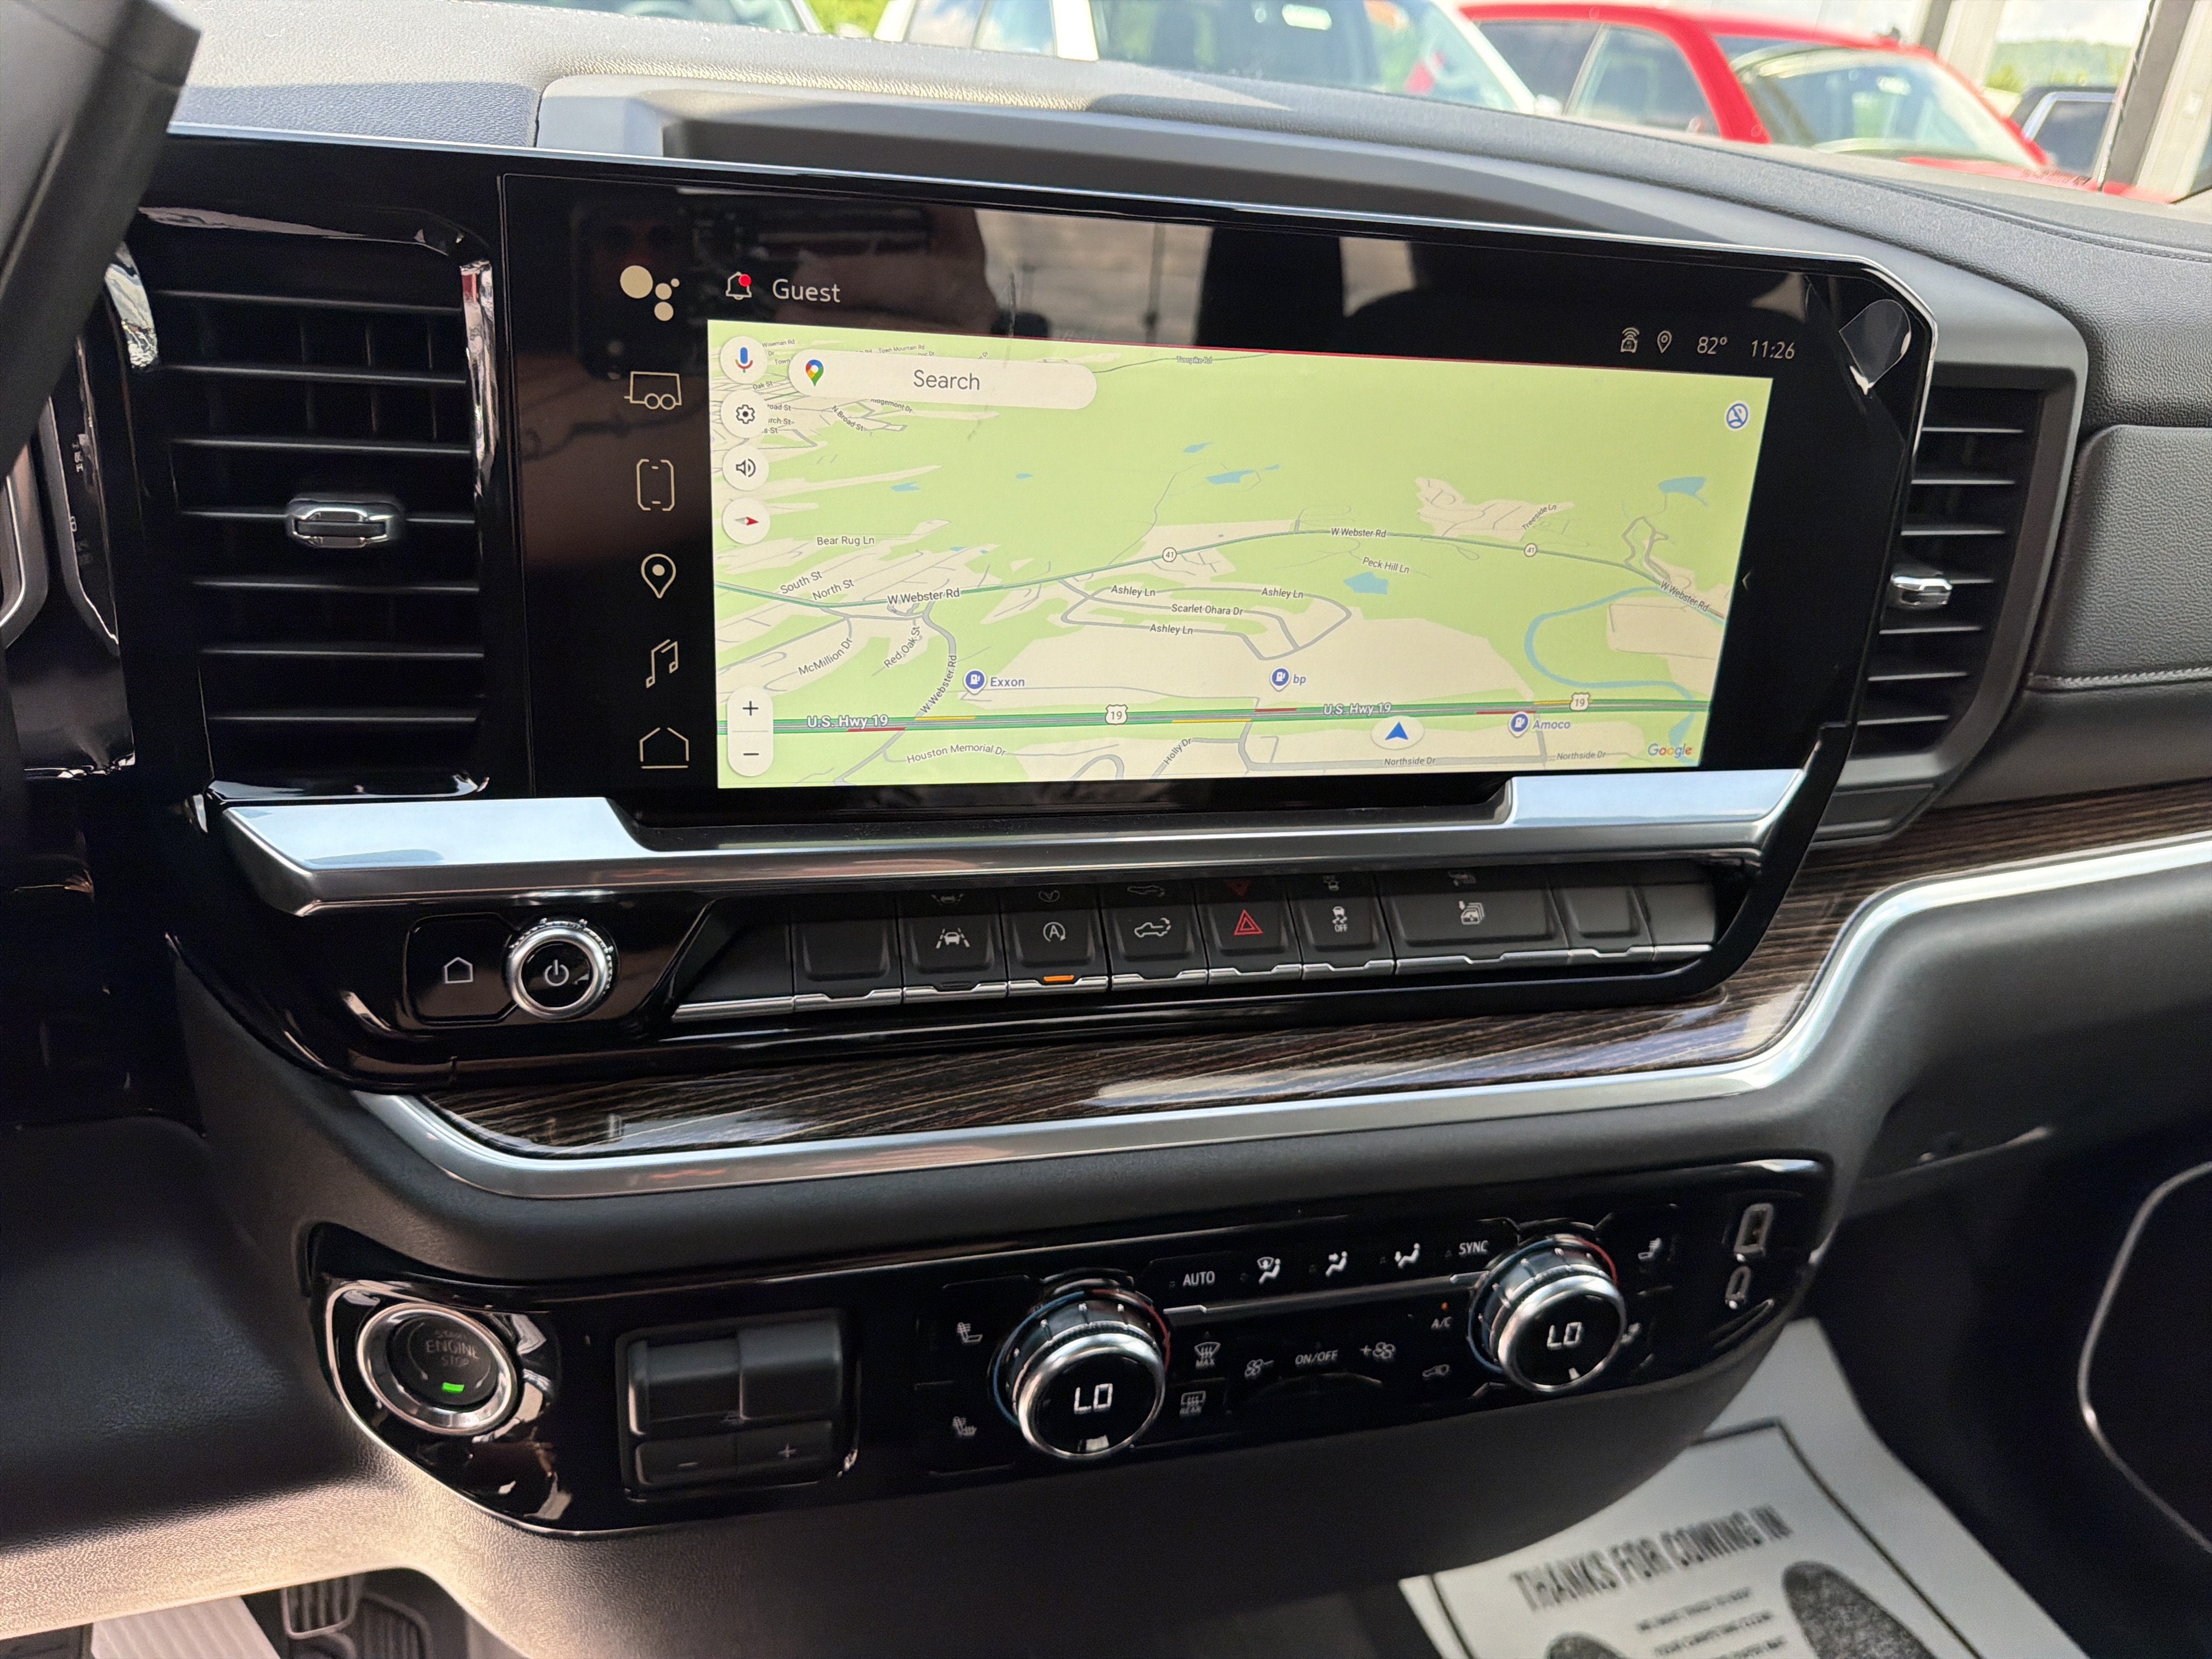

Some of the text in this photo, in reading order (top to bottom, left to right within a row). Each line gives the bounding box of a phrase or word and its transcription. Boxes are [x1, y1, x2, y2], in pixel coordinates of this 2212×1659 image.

[772, 279, 840, 303] Guest
[1696, 336, 1728, 354] 82°
[1751, 340, 1796, 359] 11:26
[913, 369, 980, 390] Search
[837, 411, 856, 427] Broad
[855, 422, 864, 432] St
[1521, 507, 1547, 531] Treeside
[1331, 527, 1387, 538] W Webster Rd
[817, 536, 874, 547] Bear Rug Ln
[1165, 550, 1175, 558] 41
[1362, 556, 1409, 574] Peck Hill Ln
[780, 569, 823, 595] South St
[812, 578, 855, 601] North St
[887, 587, 960, 605] W Webster Rd
[1110, 585, 1156, 599] Ashley Ln
[1261, 587, 1304, 600] Ashley Ln
[1660, 580, 1710, 612] W Webster Rd
[1171, 603, 1243, 616] Scarlet Ohara Dr
[1150, 624, 1193, 636] Ashley Ln
[883, 625, 920, 668] Red Oak St
[798, 636, 854, 675] McMillion Dr
[920, 654, 957, 713] W Webster Rd
[990, 676, 1025, 688] Exxon
[1293, 674, 1306, 686] bp
[1323, 702, 1392, 717] U.S. Hwy 19
[1575, 697, 1585, 708] 19
[807, 714, 889, 730] U.S. Hwy 19
[1110, 710, 1122, 721] 19
[1532, 719, 1571, 730] Amoco
[907, 744, 1006, 764] Houston Memorial Dr
[1163, 736, 1192, 765] Holly Dr
[1556, 751, 1606, 760] Northside Dr
[1647, 743, 1692, 758] Google
[1384, 756, 1436, 766] Northside Dr
[1334, 924, 1348, 932] OFF
[1458, 1240, 1489, 1256] SYNC
[1183, 1271, 1215, 1286] AUTO
[1430, 1317, 1453, 1330] A/C
[1547, 1321, 1583, 1350] LO
[426, 1339, 479, 1360] ENGINE
[1295, 1350, 1339, 1365] ON/OFF
[1195, 1358, 1215, 1369] MAX
[1074, 1383, 1113, 1415] LO
[1511, 1550, 1618, 1612] THANKS
[1610, 1537, 1675, 1589] FOR
[1748, 1504, 1794, 1542] IN
